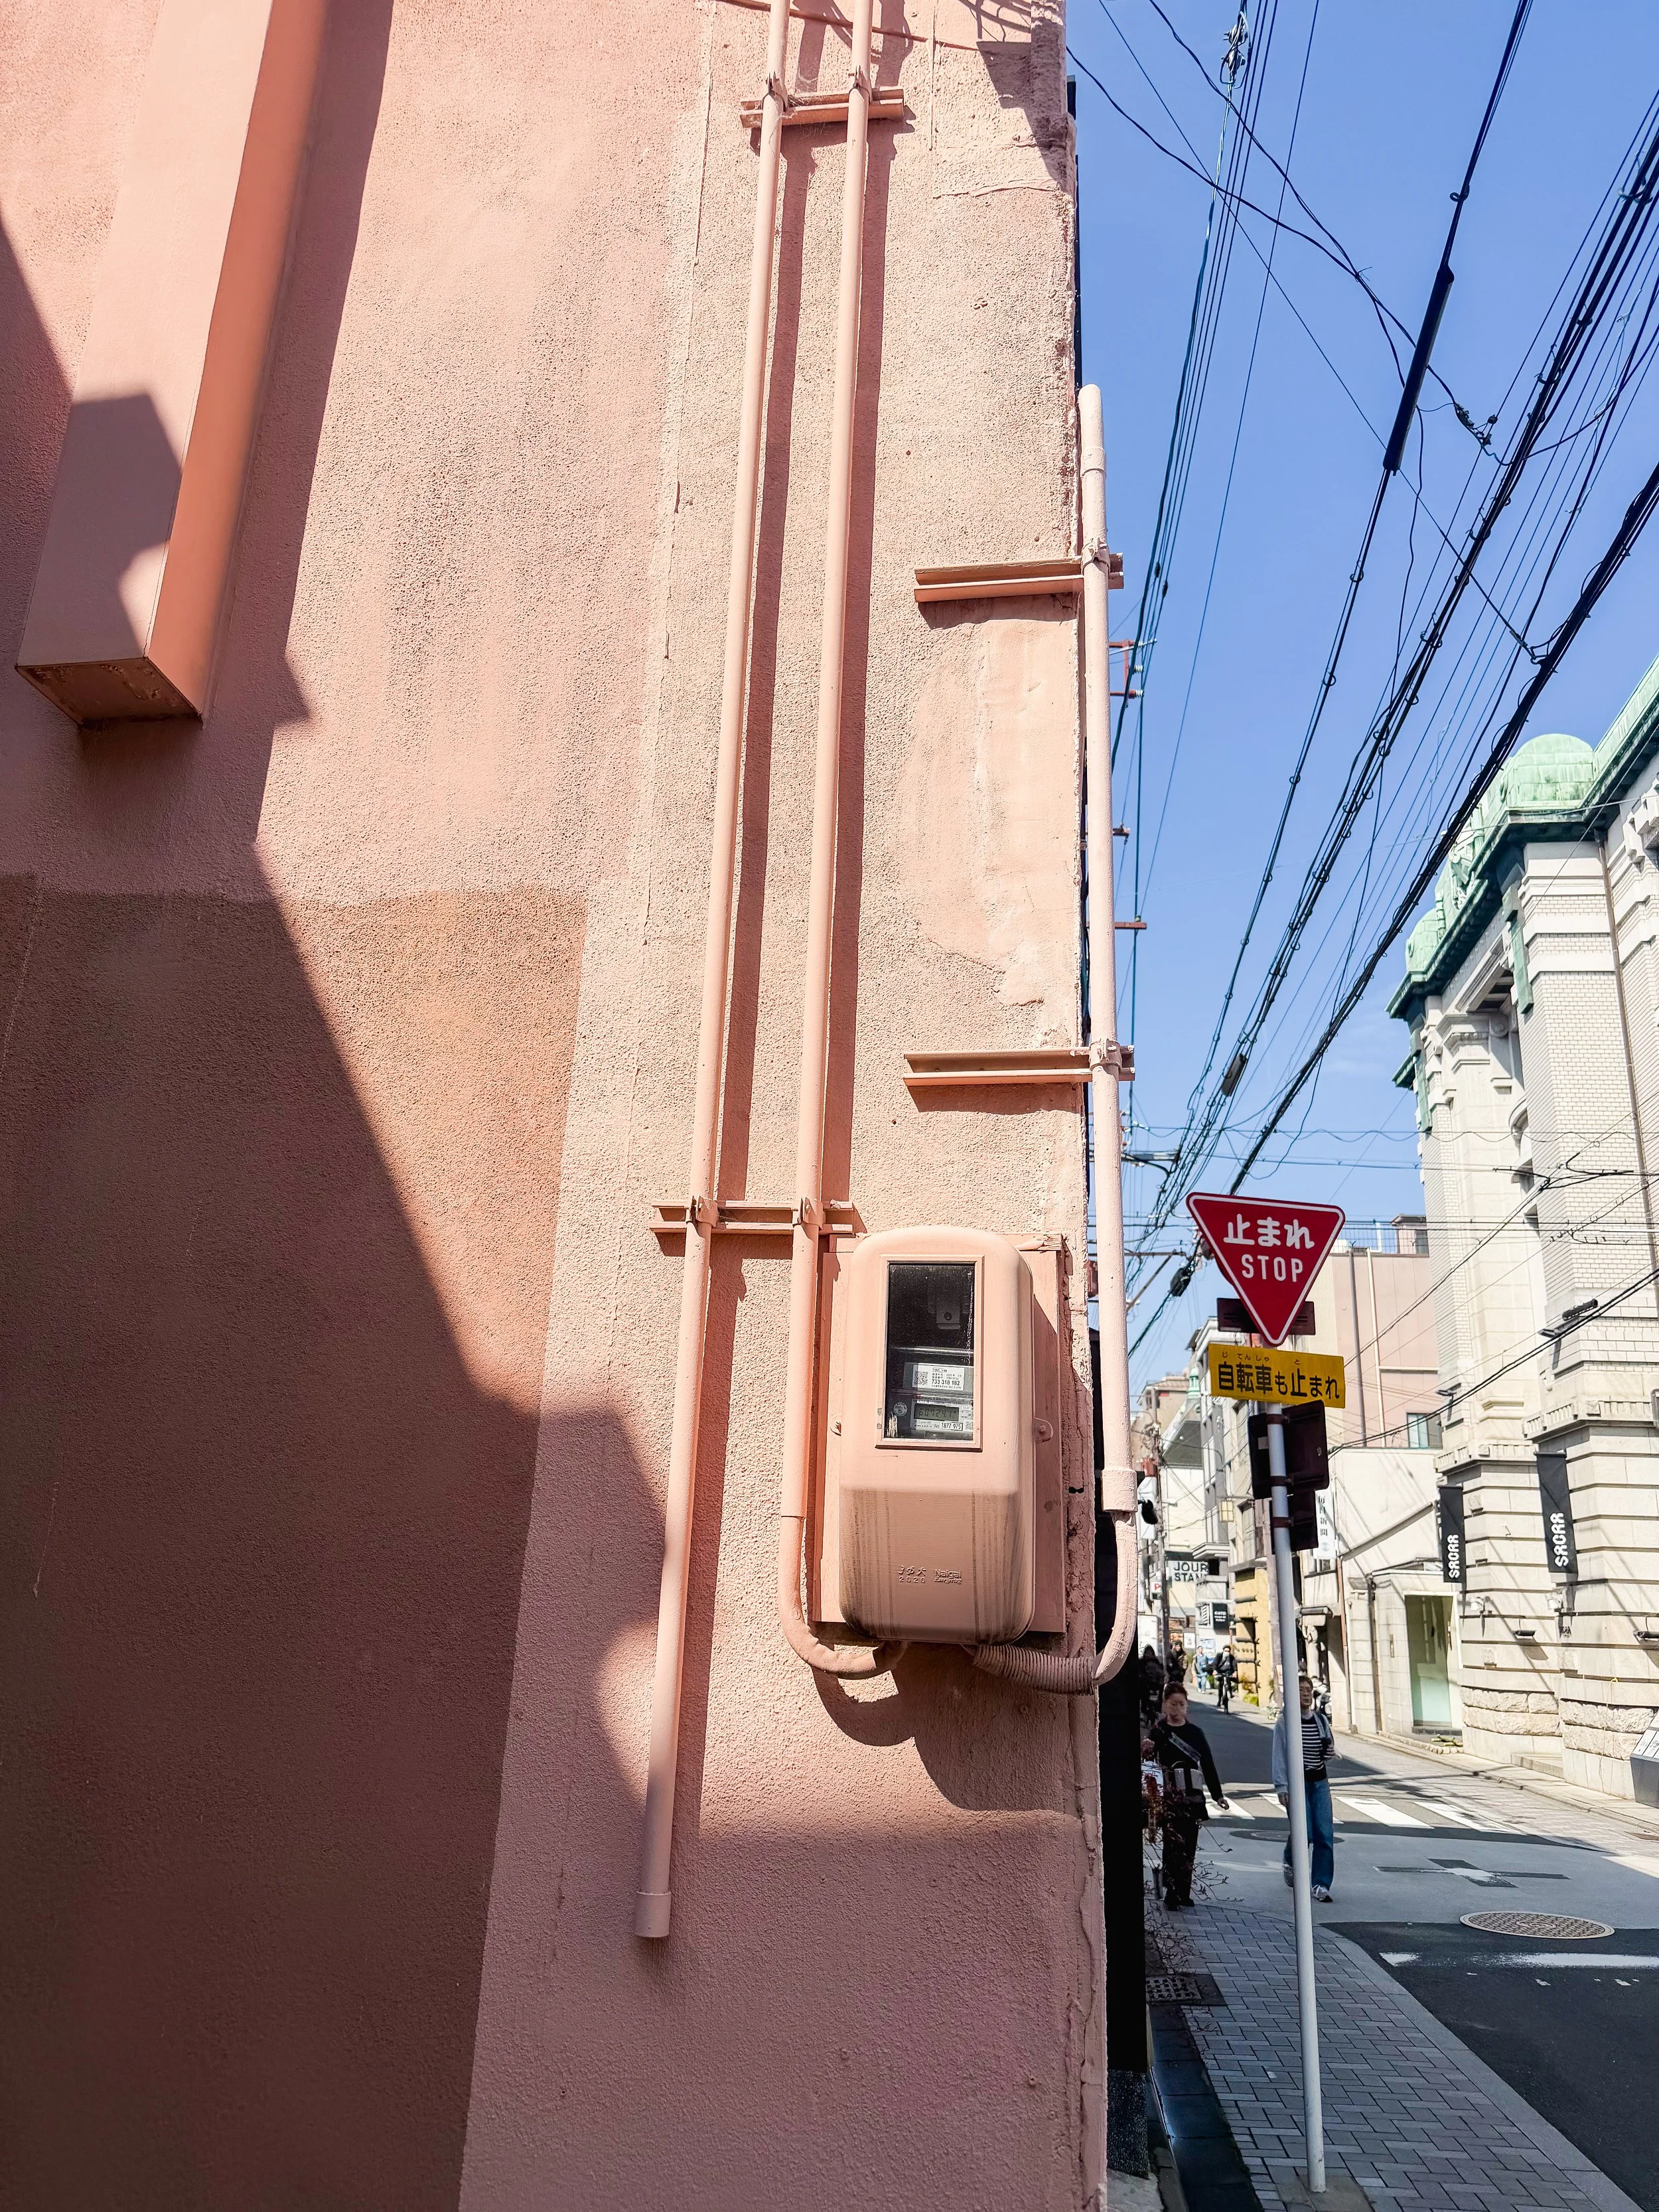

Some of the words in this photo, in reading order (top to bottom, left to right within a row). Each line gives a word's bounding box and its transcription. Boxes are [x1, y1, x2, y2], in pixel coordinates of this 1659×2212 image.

[1223, 1213, 1315, 1250] 止まれ
[1242, 1254, 1303, 1282] STOP
[1218, 1361, 1340, 1400] 自転車も止まれ
[934, 1569, 962, 1579] Naigai
